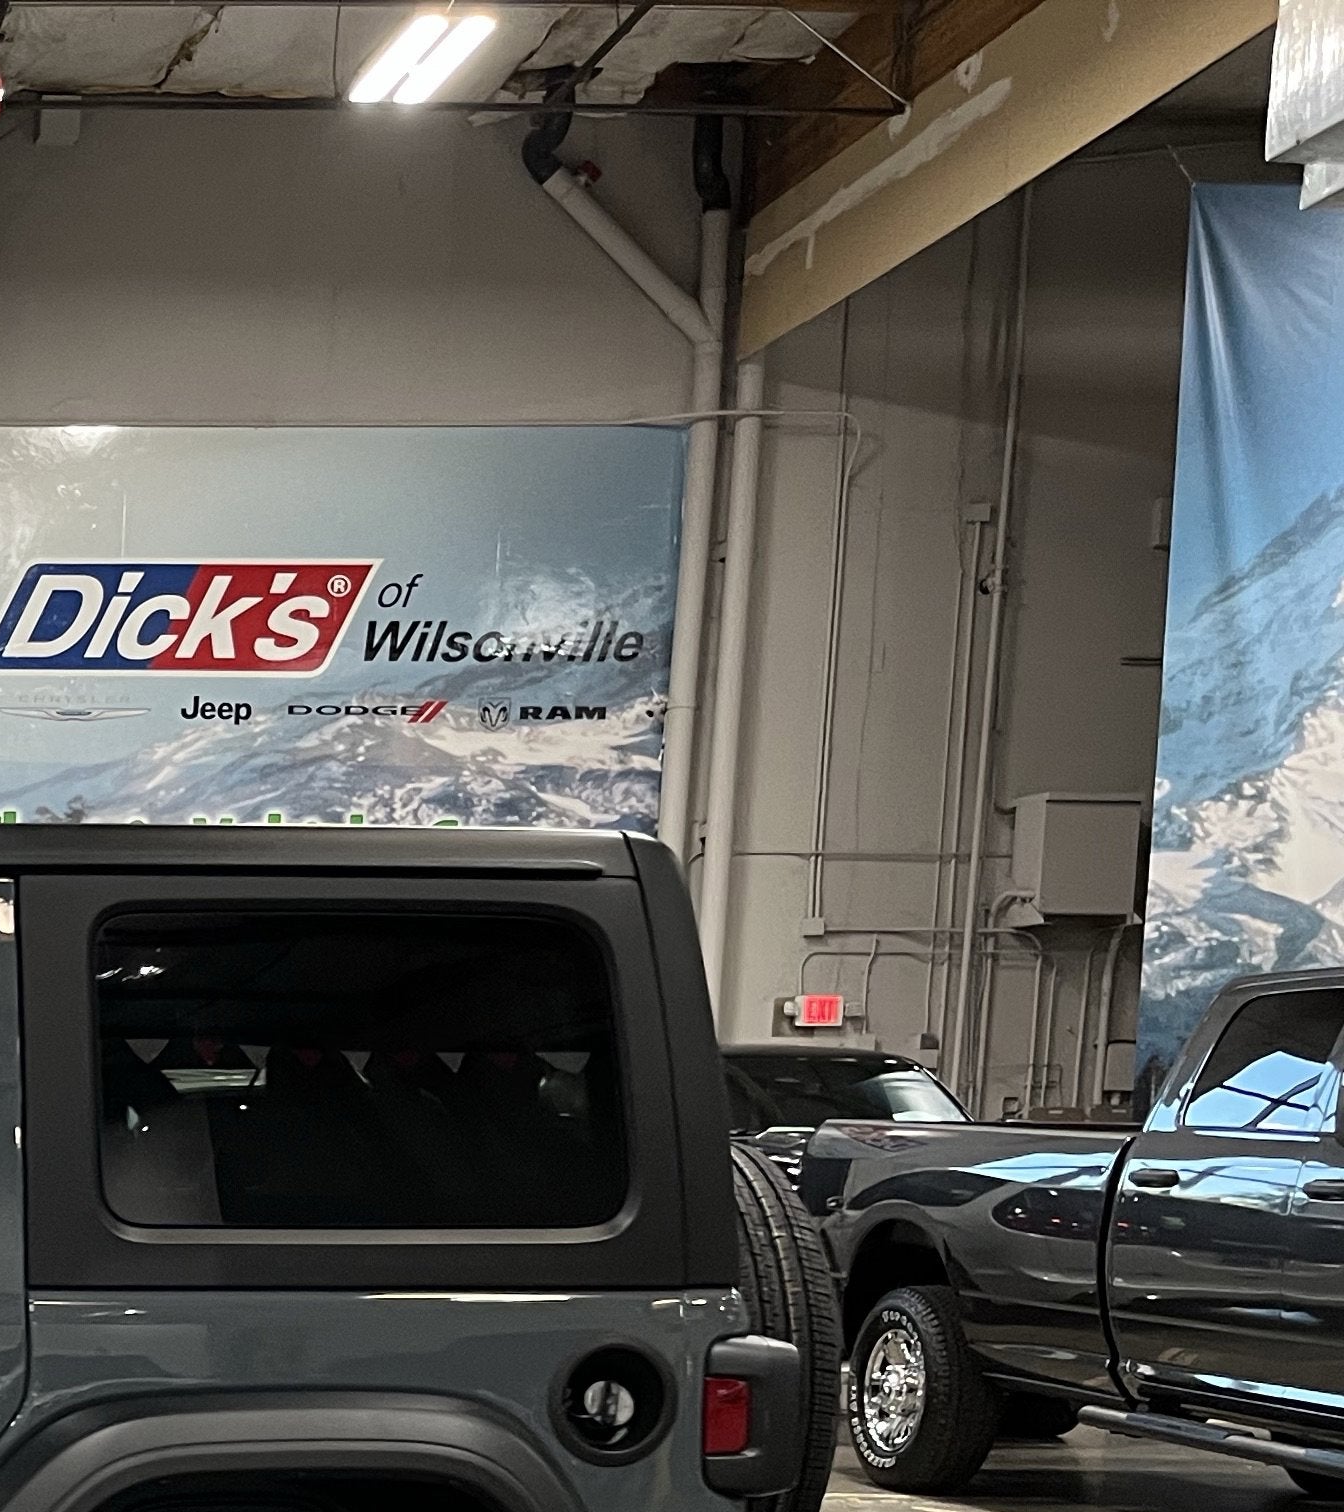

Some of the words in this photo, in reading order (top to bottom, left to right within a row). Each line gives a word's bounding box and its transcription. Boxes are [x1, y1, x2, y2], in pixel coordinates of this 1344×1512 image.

[2, 571, 330, 661] Dick's
[377, 573, 424, 609] of
[363, 620, 645, 663] Wilsonville
[180, 695, 253, 726] Jeep
[287, 704, 425, 716] DODGE
[519, 705, 607, 720] RAM
[807, 1000, 840, 1022] EXIT
